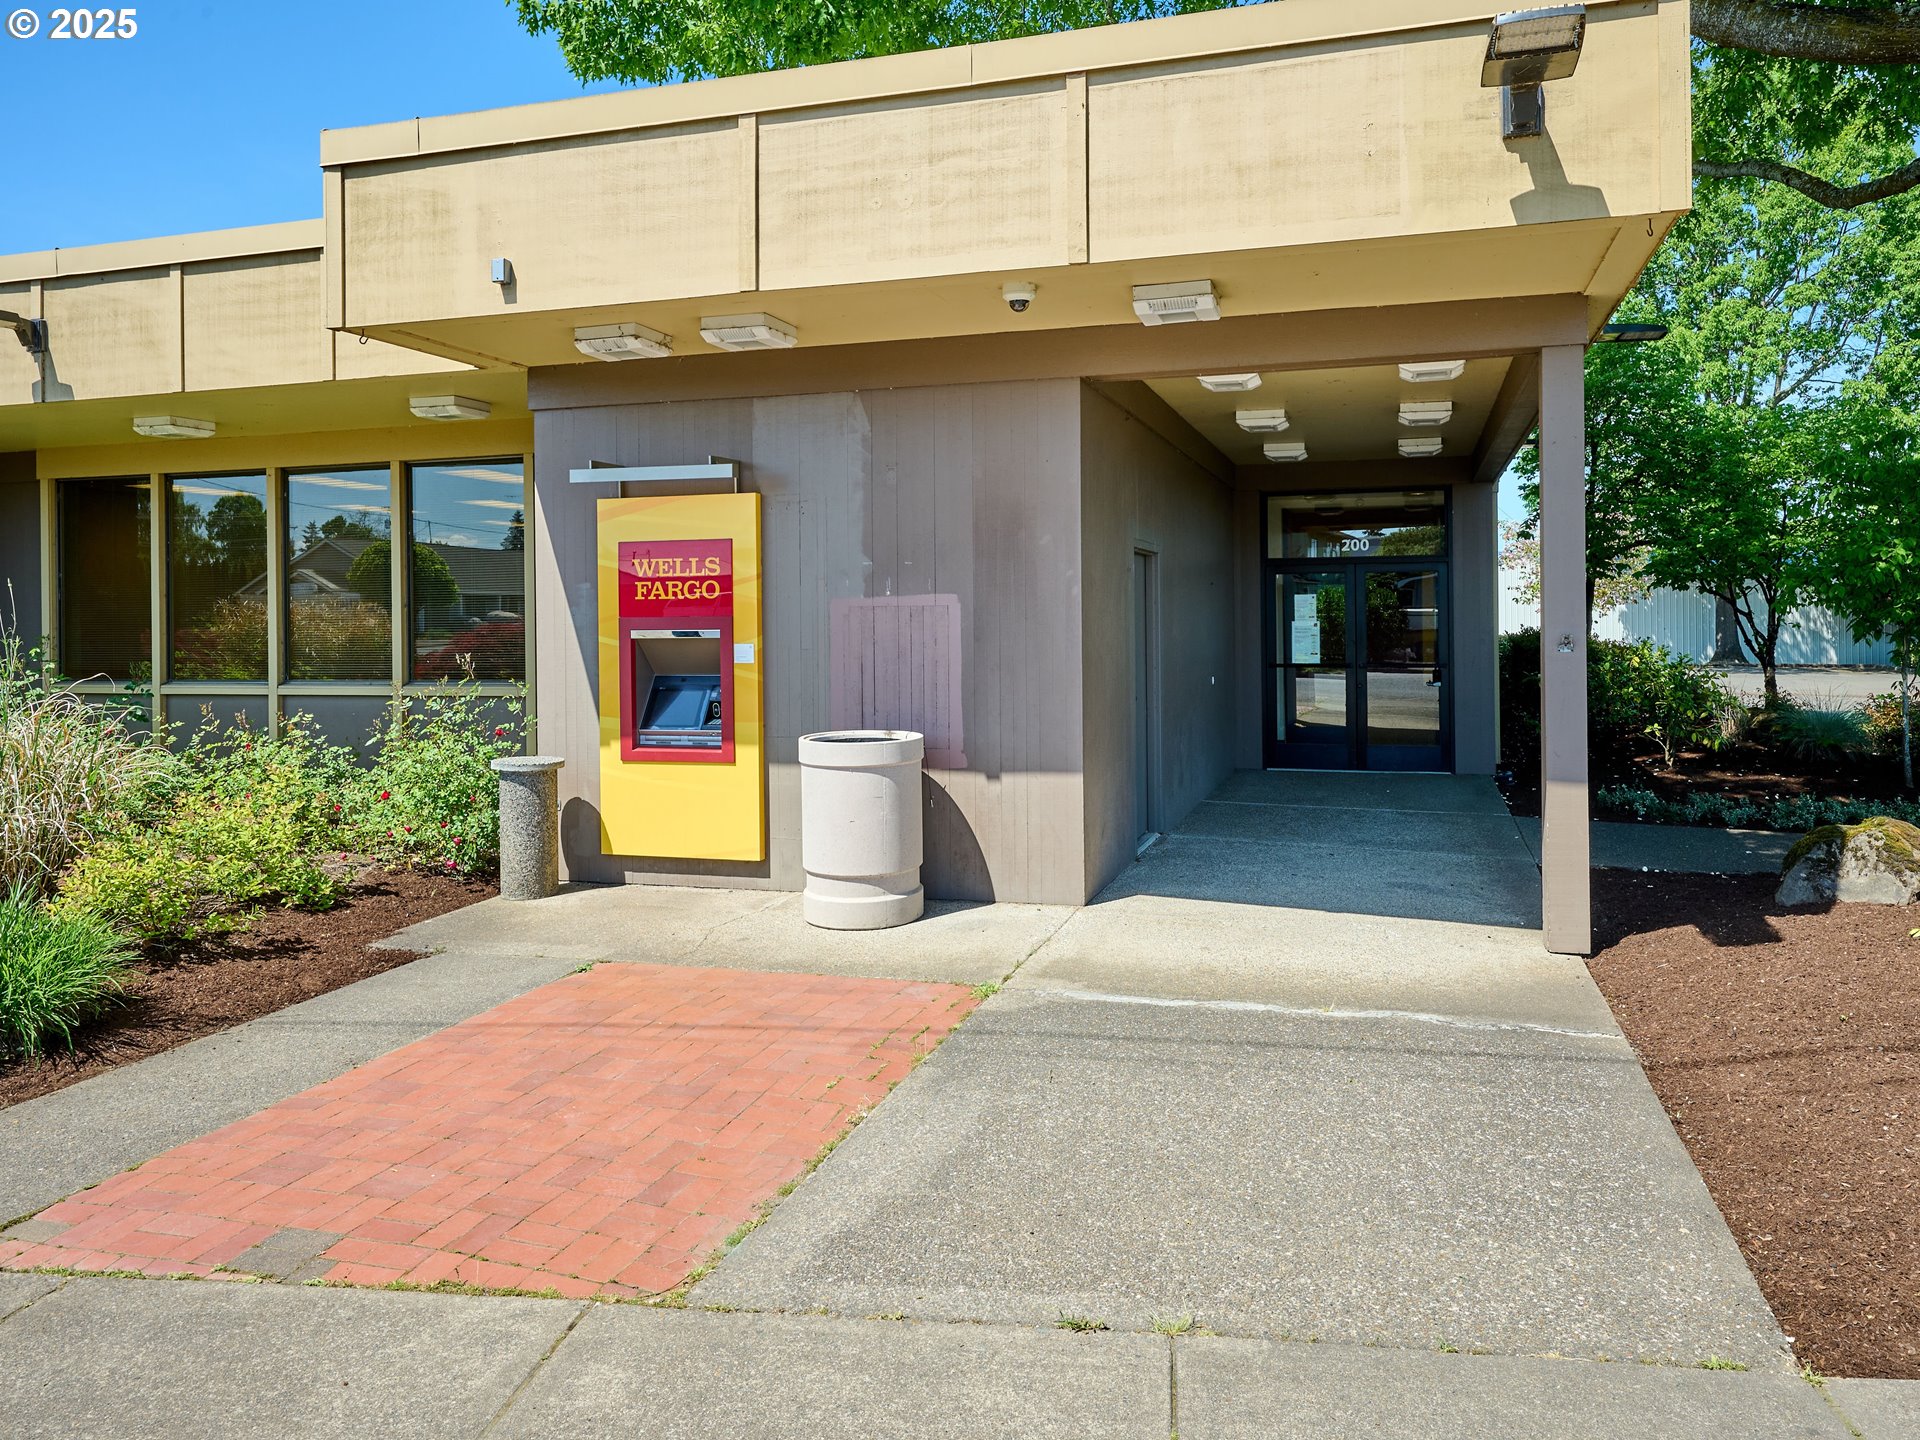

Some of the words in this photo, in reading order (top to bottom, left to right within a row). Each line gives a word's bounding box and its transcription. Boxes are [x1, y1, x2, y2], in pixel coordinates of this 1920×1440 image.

[1341, 538, 1370, 552] 200
[632, 557, 721, 578] WELLS
[634, 579, 720, 600] FARGO
